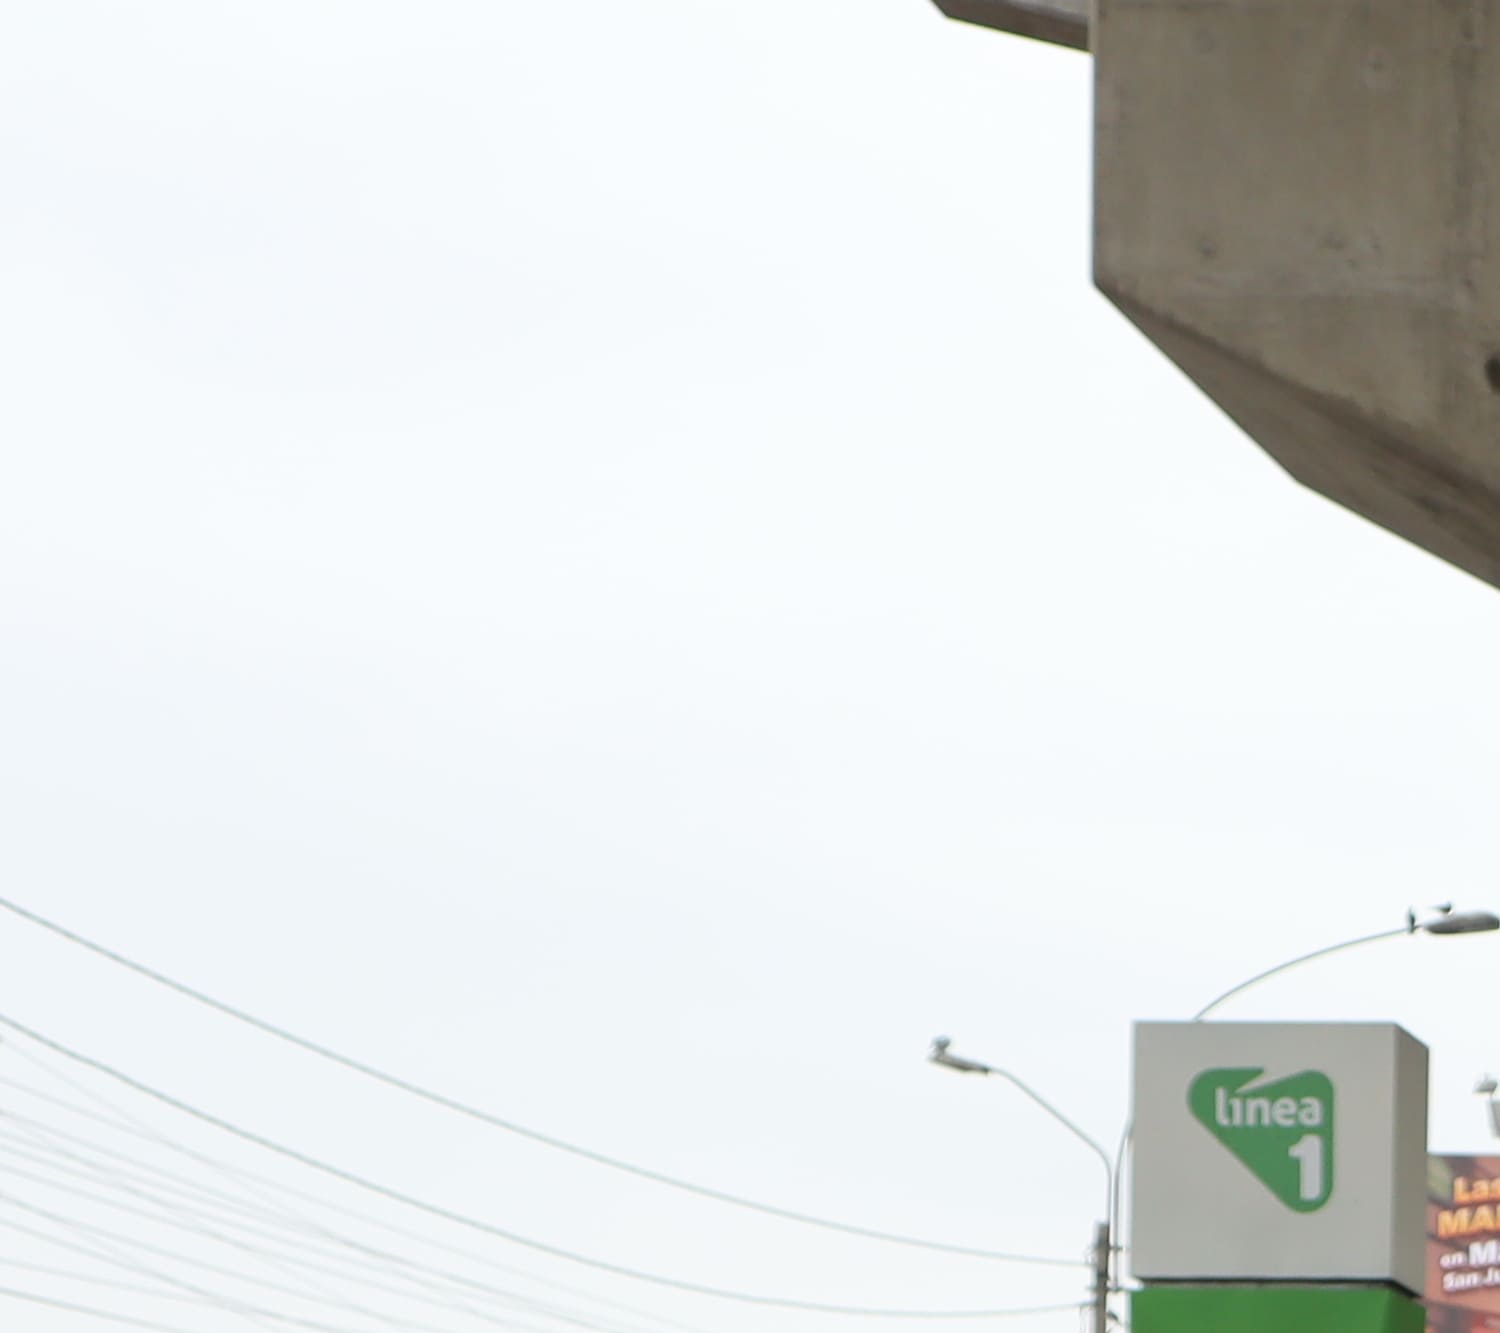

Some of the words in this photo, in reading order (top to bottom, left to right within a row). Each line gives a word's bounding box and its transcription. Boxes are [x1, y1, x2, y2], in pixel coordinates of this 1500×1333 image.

[1215, 1086, 1322, 1127] línea
[1288, 1134, 1322, 1201] 1
[1440, 1251, 1466, 1268] en
[1443, 1272, 1477, 1291] San
